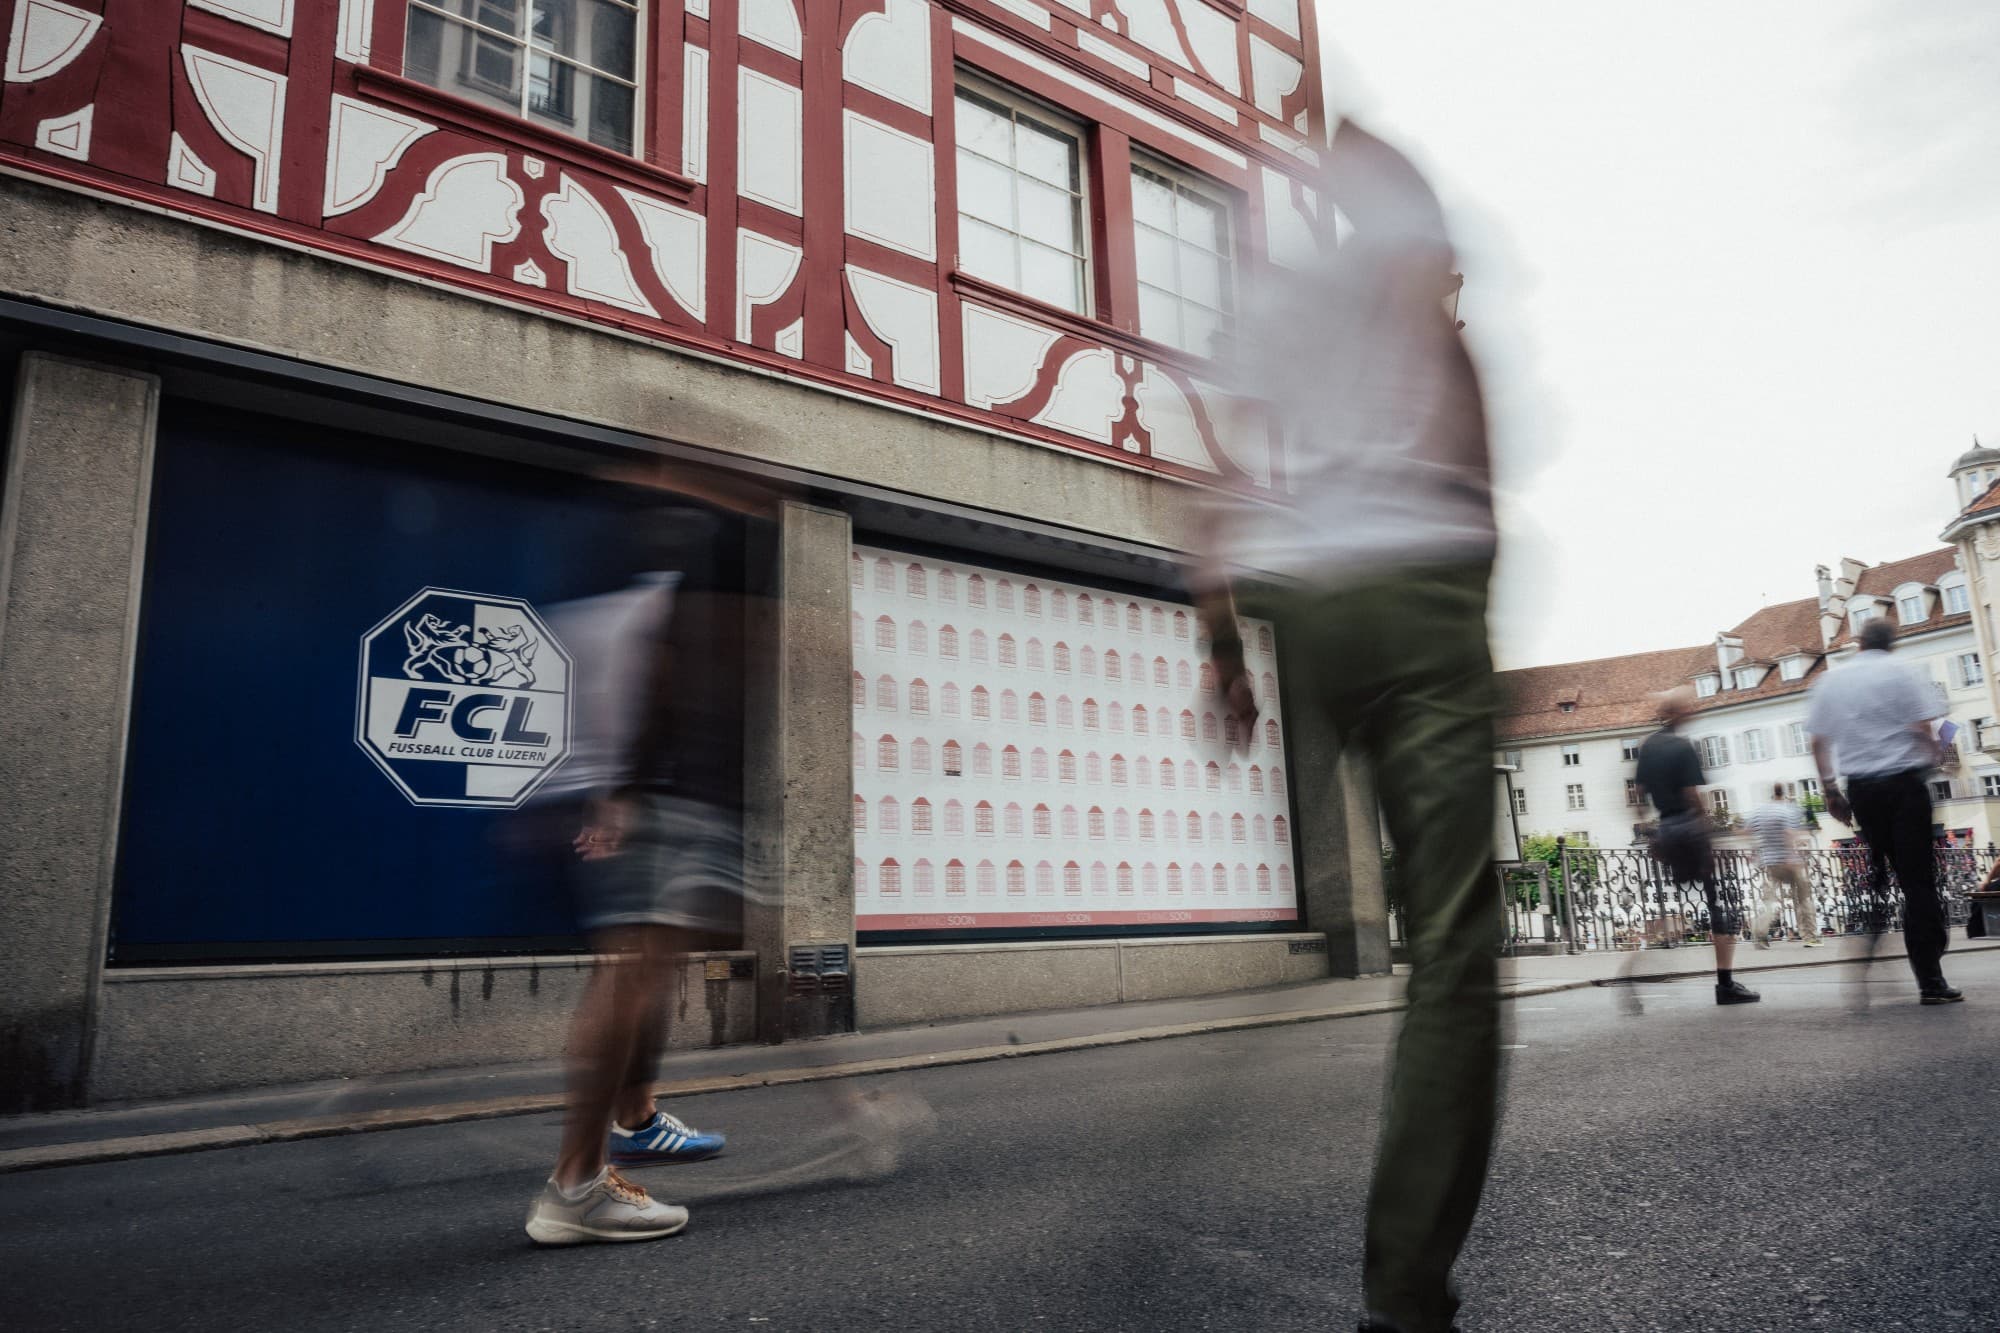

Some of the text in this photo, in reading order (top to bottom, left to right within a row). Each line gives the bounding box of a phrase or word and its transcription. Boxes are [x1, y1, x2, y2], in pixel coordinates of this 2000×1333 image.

[394, 687, 551, 747] FCL
[388, 742, 547, 762] FUSSBALL CLUB LUZERN
[947, 914, 976, 926] SOON
[1168, 911, 1192, 921] SOON
